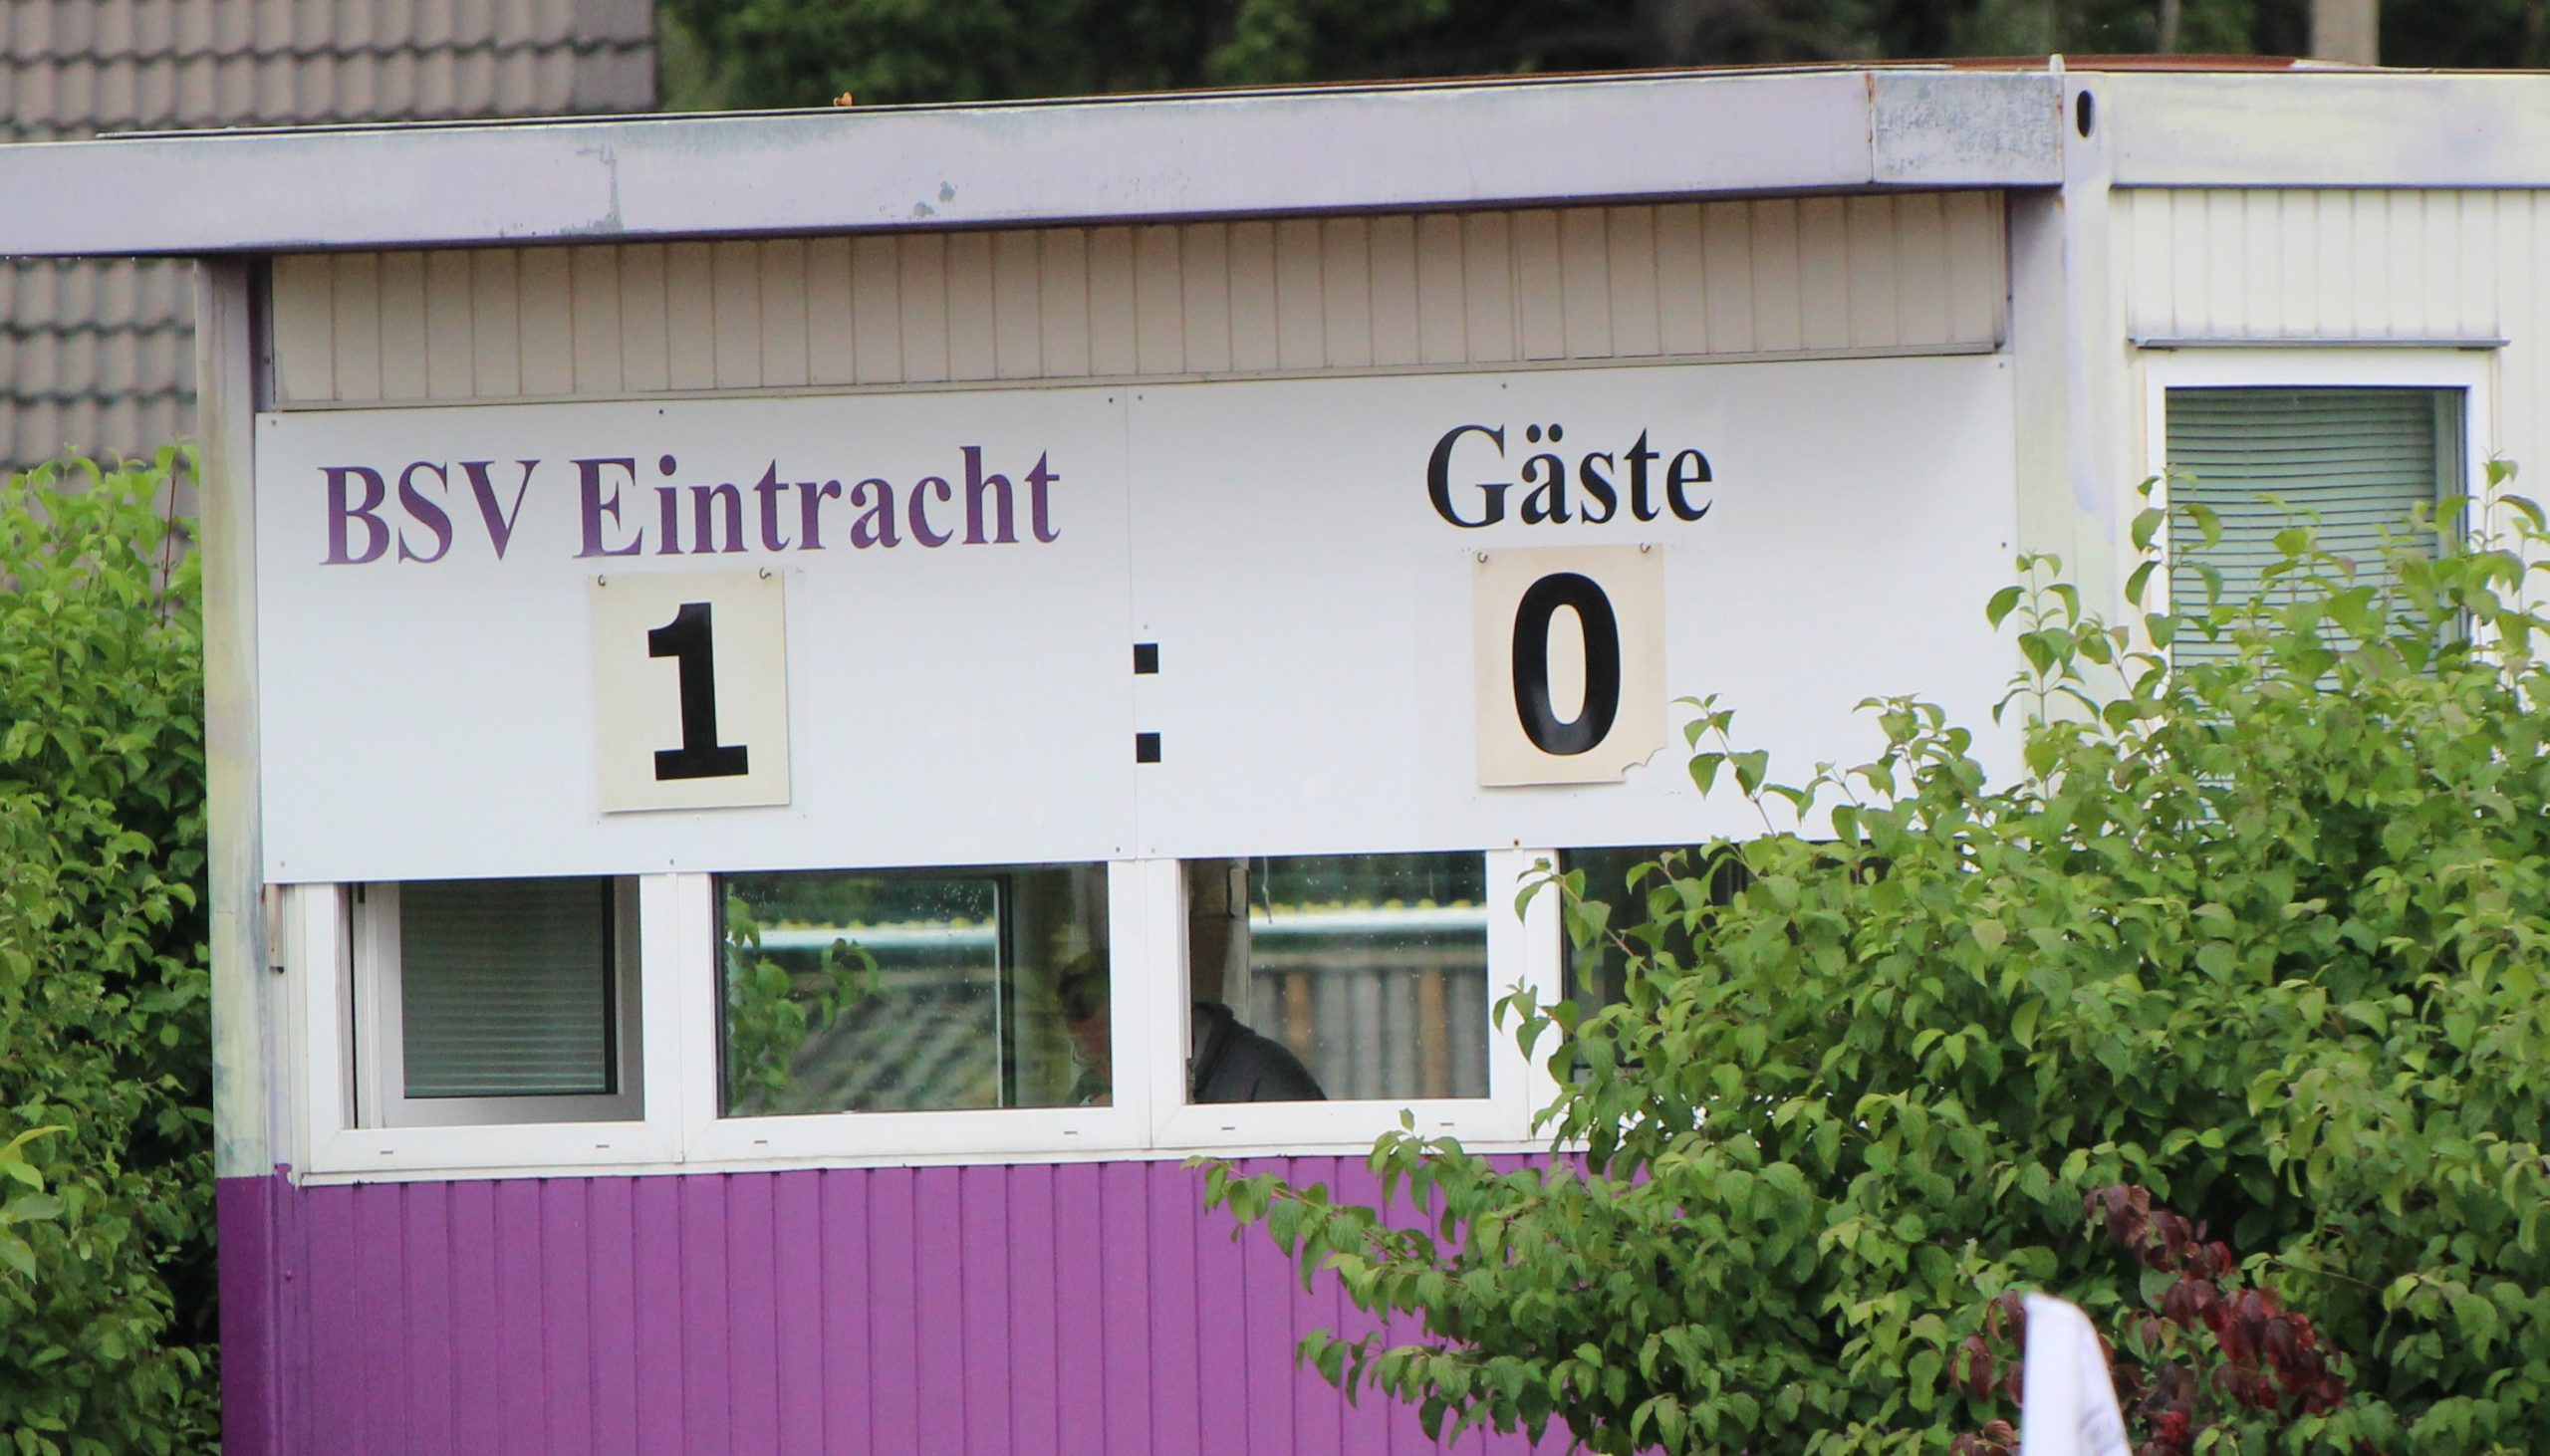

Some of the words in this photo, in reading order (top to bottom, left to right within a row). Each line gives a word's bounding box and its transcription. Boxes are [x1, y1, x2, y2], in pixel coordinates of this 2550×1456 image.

[316, 458, 542, 566] BSV
[568, 444, 1063, 560] Eintracht
[1425, 422, 1714, 529] Gäste
[647, 602, 749, 781] 1
[1512, 572, 1621, 756] 0
